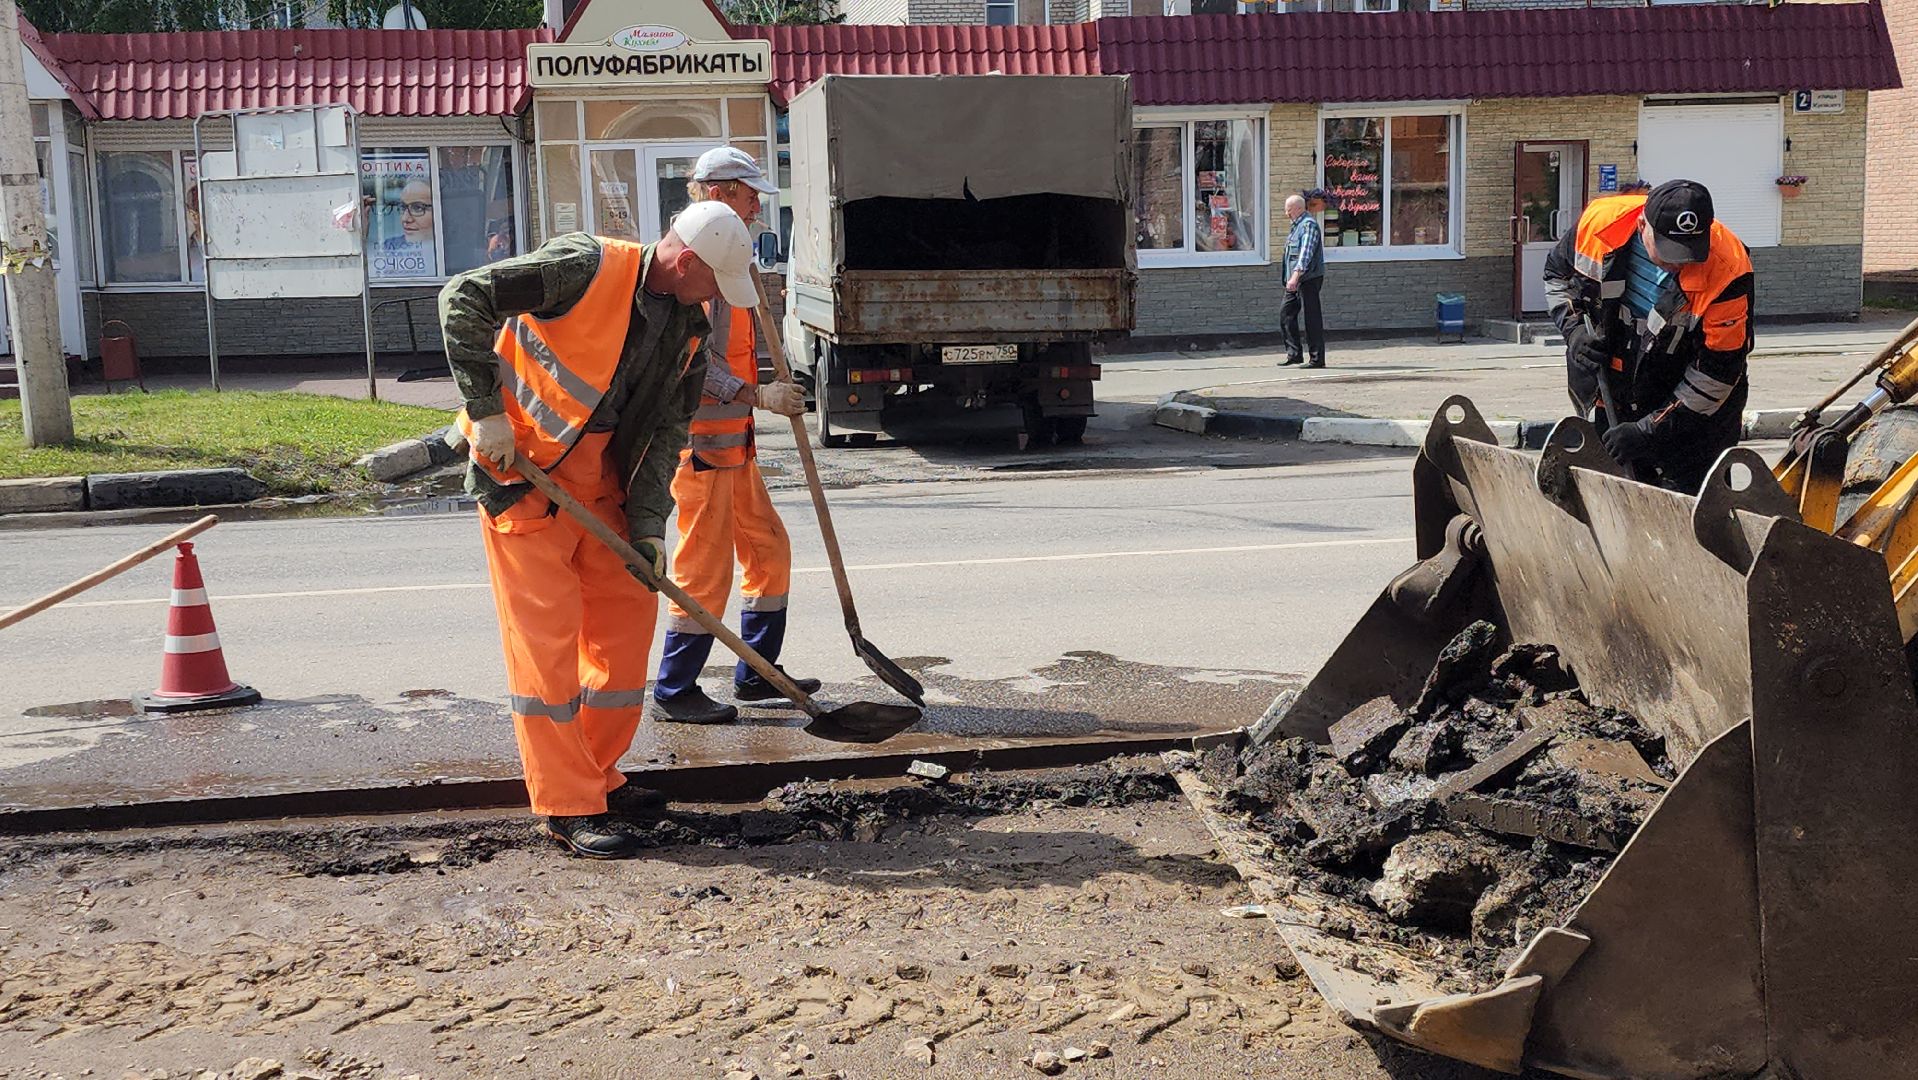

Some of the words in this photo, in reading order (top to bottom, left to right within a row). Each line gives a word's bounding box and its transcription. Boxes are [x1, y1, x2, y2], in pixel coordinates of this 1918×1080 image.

[537, 53, 763, 77] ПОЛУФАБРИКАТЫ
[362, 162, 424, 172] ОПТИКА
[374, 257, 425, 270] ОЧКОВ
